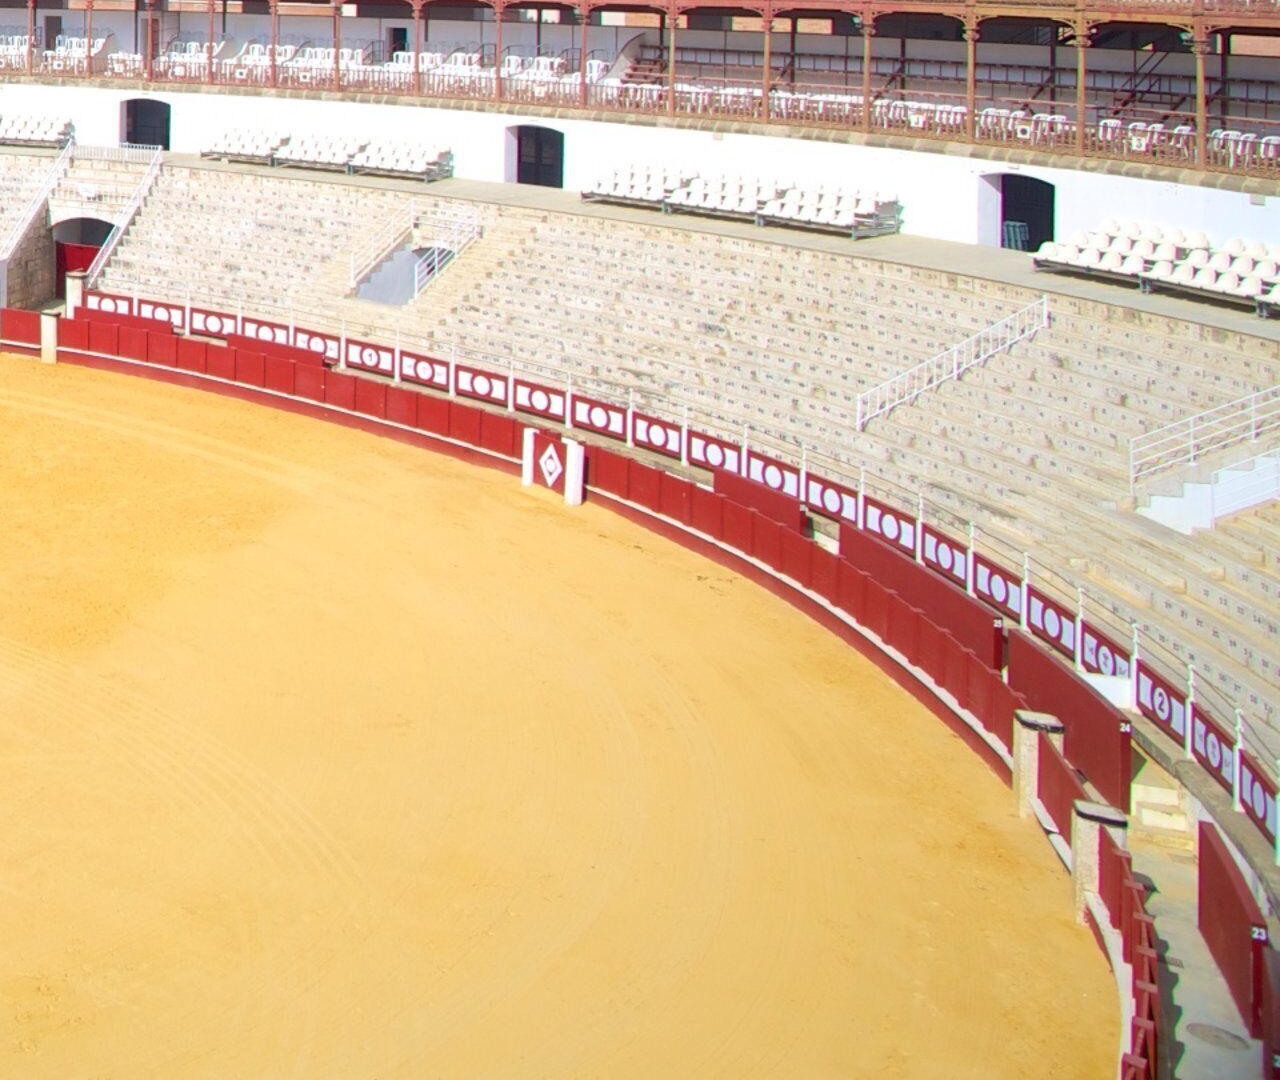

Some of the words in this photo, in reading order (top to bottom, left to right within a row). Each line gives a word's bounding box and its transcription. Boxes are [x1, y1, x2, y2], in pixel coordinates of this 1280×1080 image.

[1157, 691, 1165, 713] 2
[1120, 722, 1131, 733] 24
[1251, 925, 1267, 940] 23
